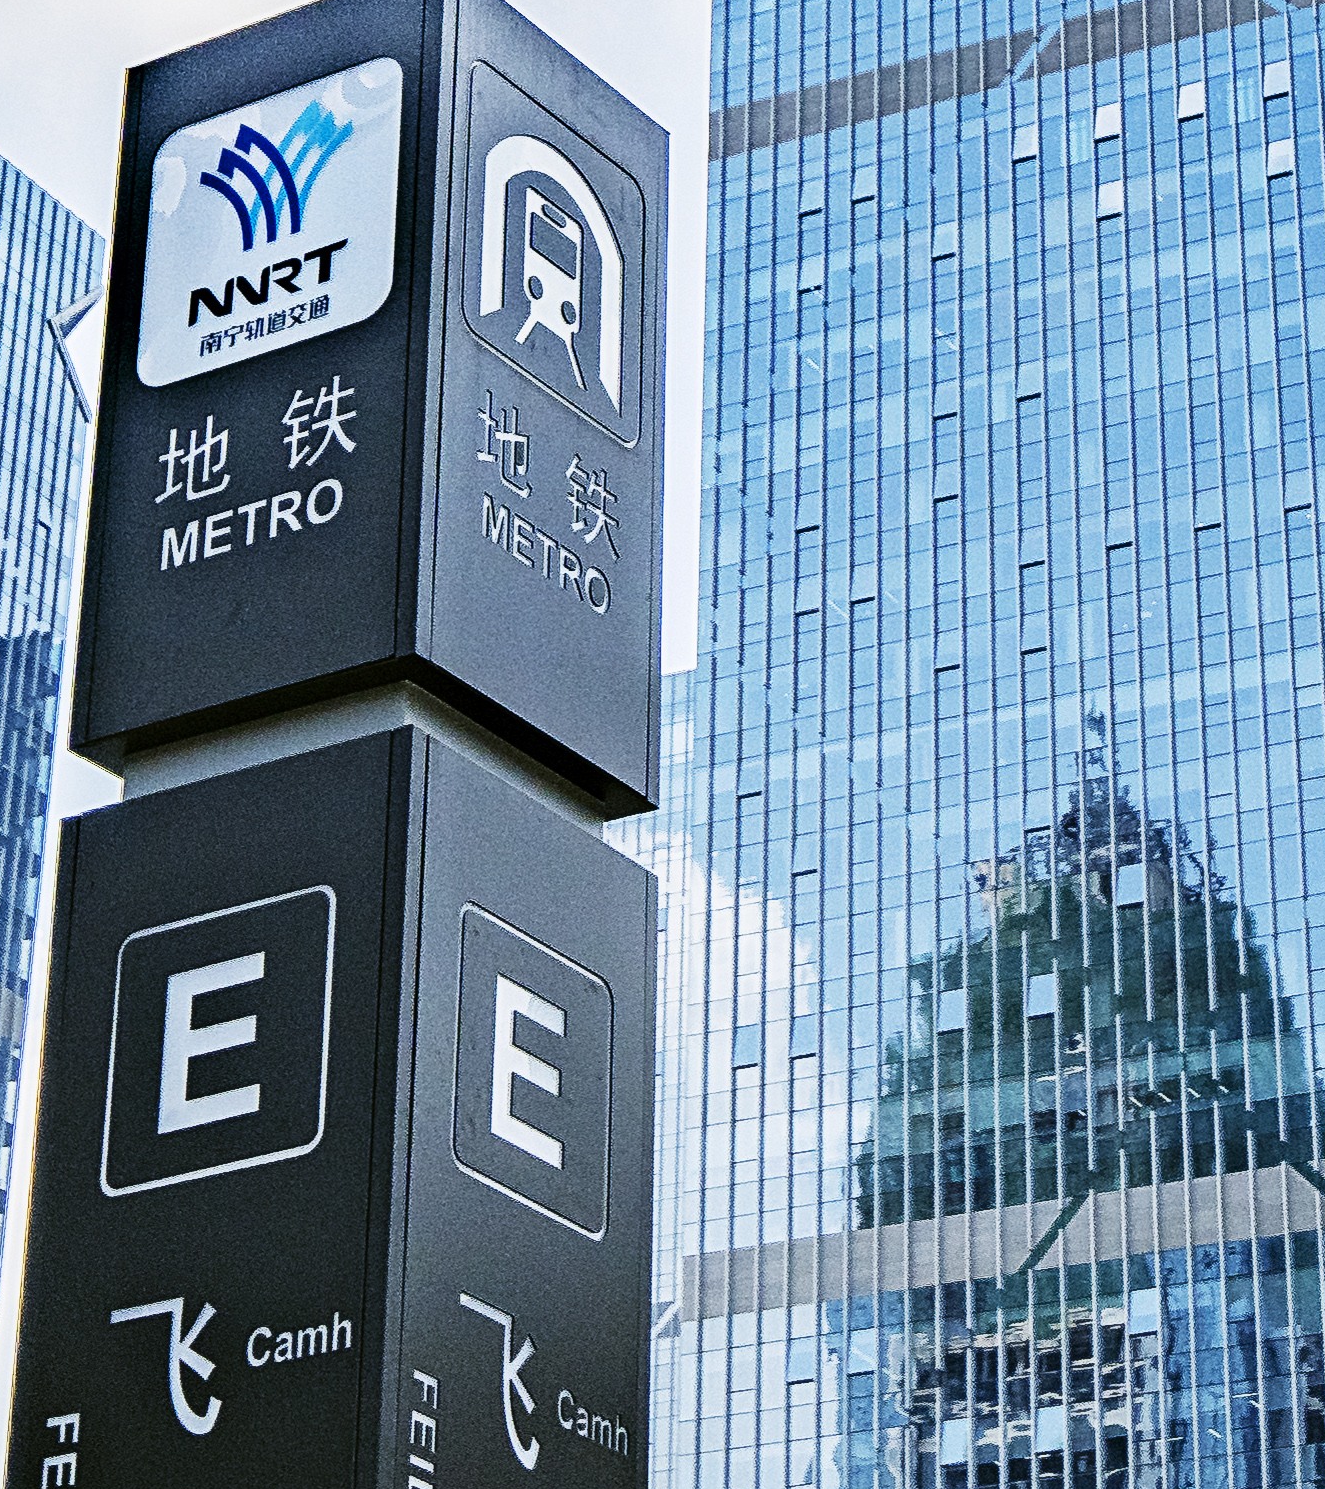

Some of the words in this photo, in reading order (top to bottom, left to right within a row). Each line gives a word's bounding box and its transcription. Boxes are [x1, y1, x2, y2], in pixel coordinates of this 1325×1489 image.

[198, 293, 331, 358] 南宁轨道交通
[159, 478, 344, 572] METRO
[481, 493, 613, 616] METRO
[156, 950, 266, 1135] E
[490, 971, 567, 1170] E
[244, 1311, 353, 1368] Camh
[556, 1388, 631, 1457] Camh
